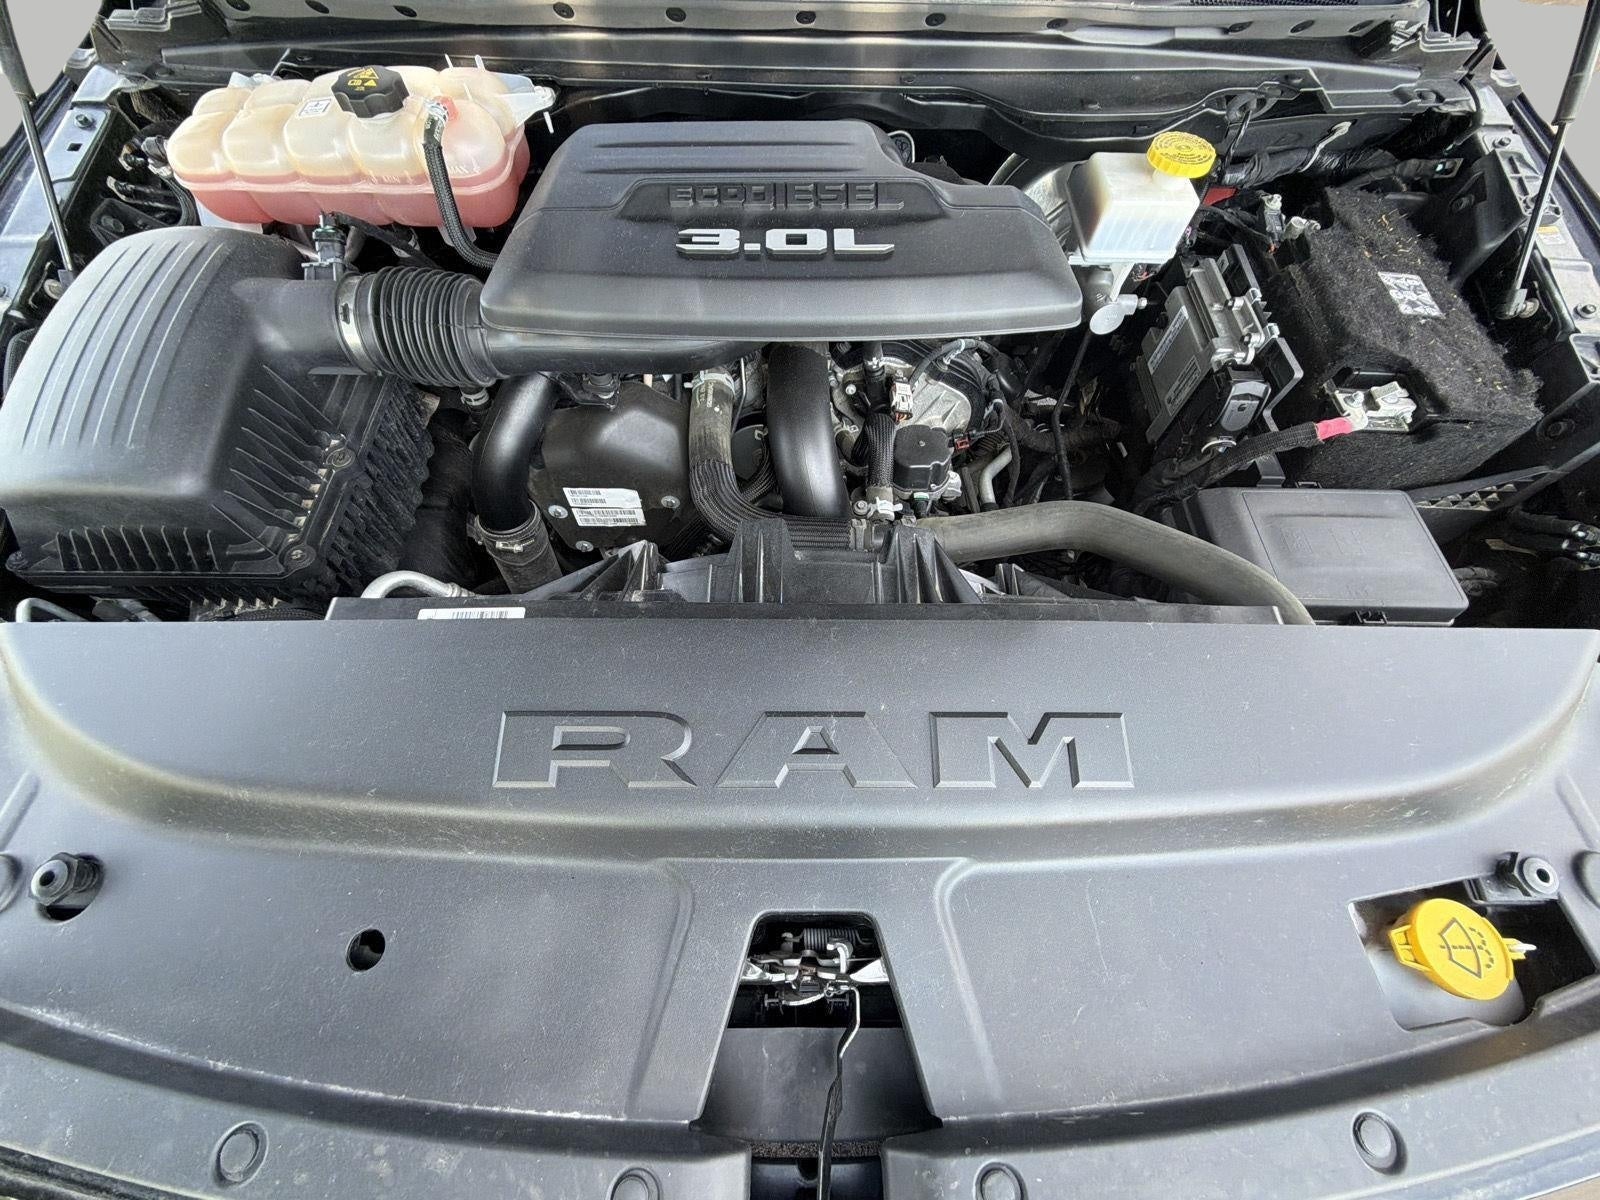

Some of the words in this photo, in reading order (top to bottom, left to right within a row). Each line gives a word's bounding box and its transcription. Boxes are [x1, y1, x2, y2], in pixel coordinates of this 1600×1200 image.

[668, 183, 904, 211] ECODIESEL
[676, 228, 895, 255] 3.0L
[492, 711, 1134, 788] RAM
